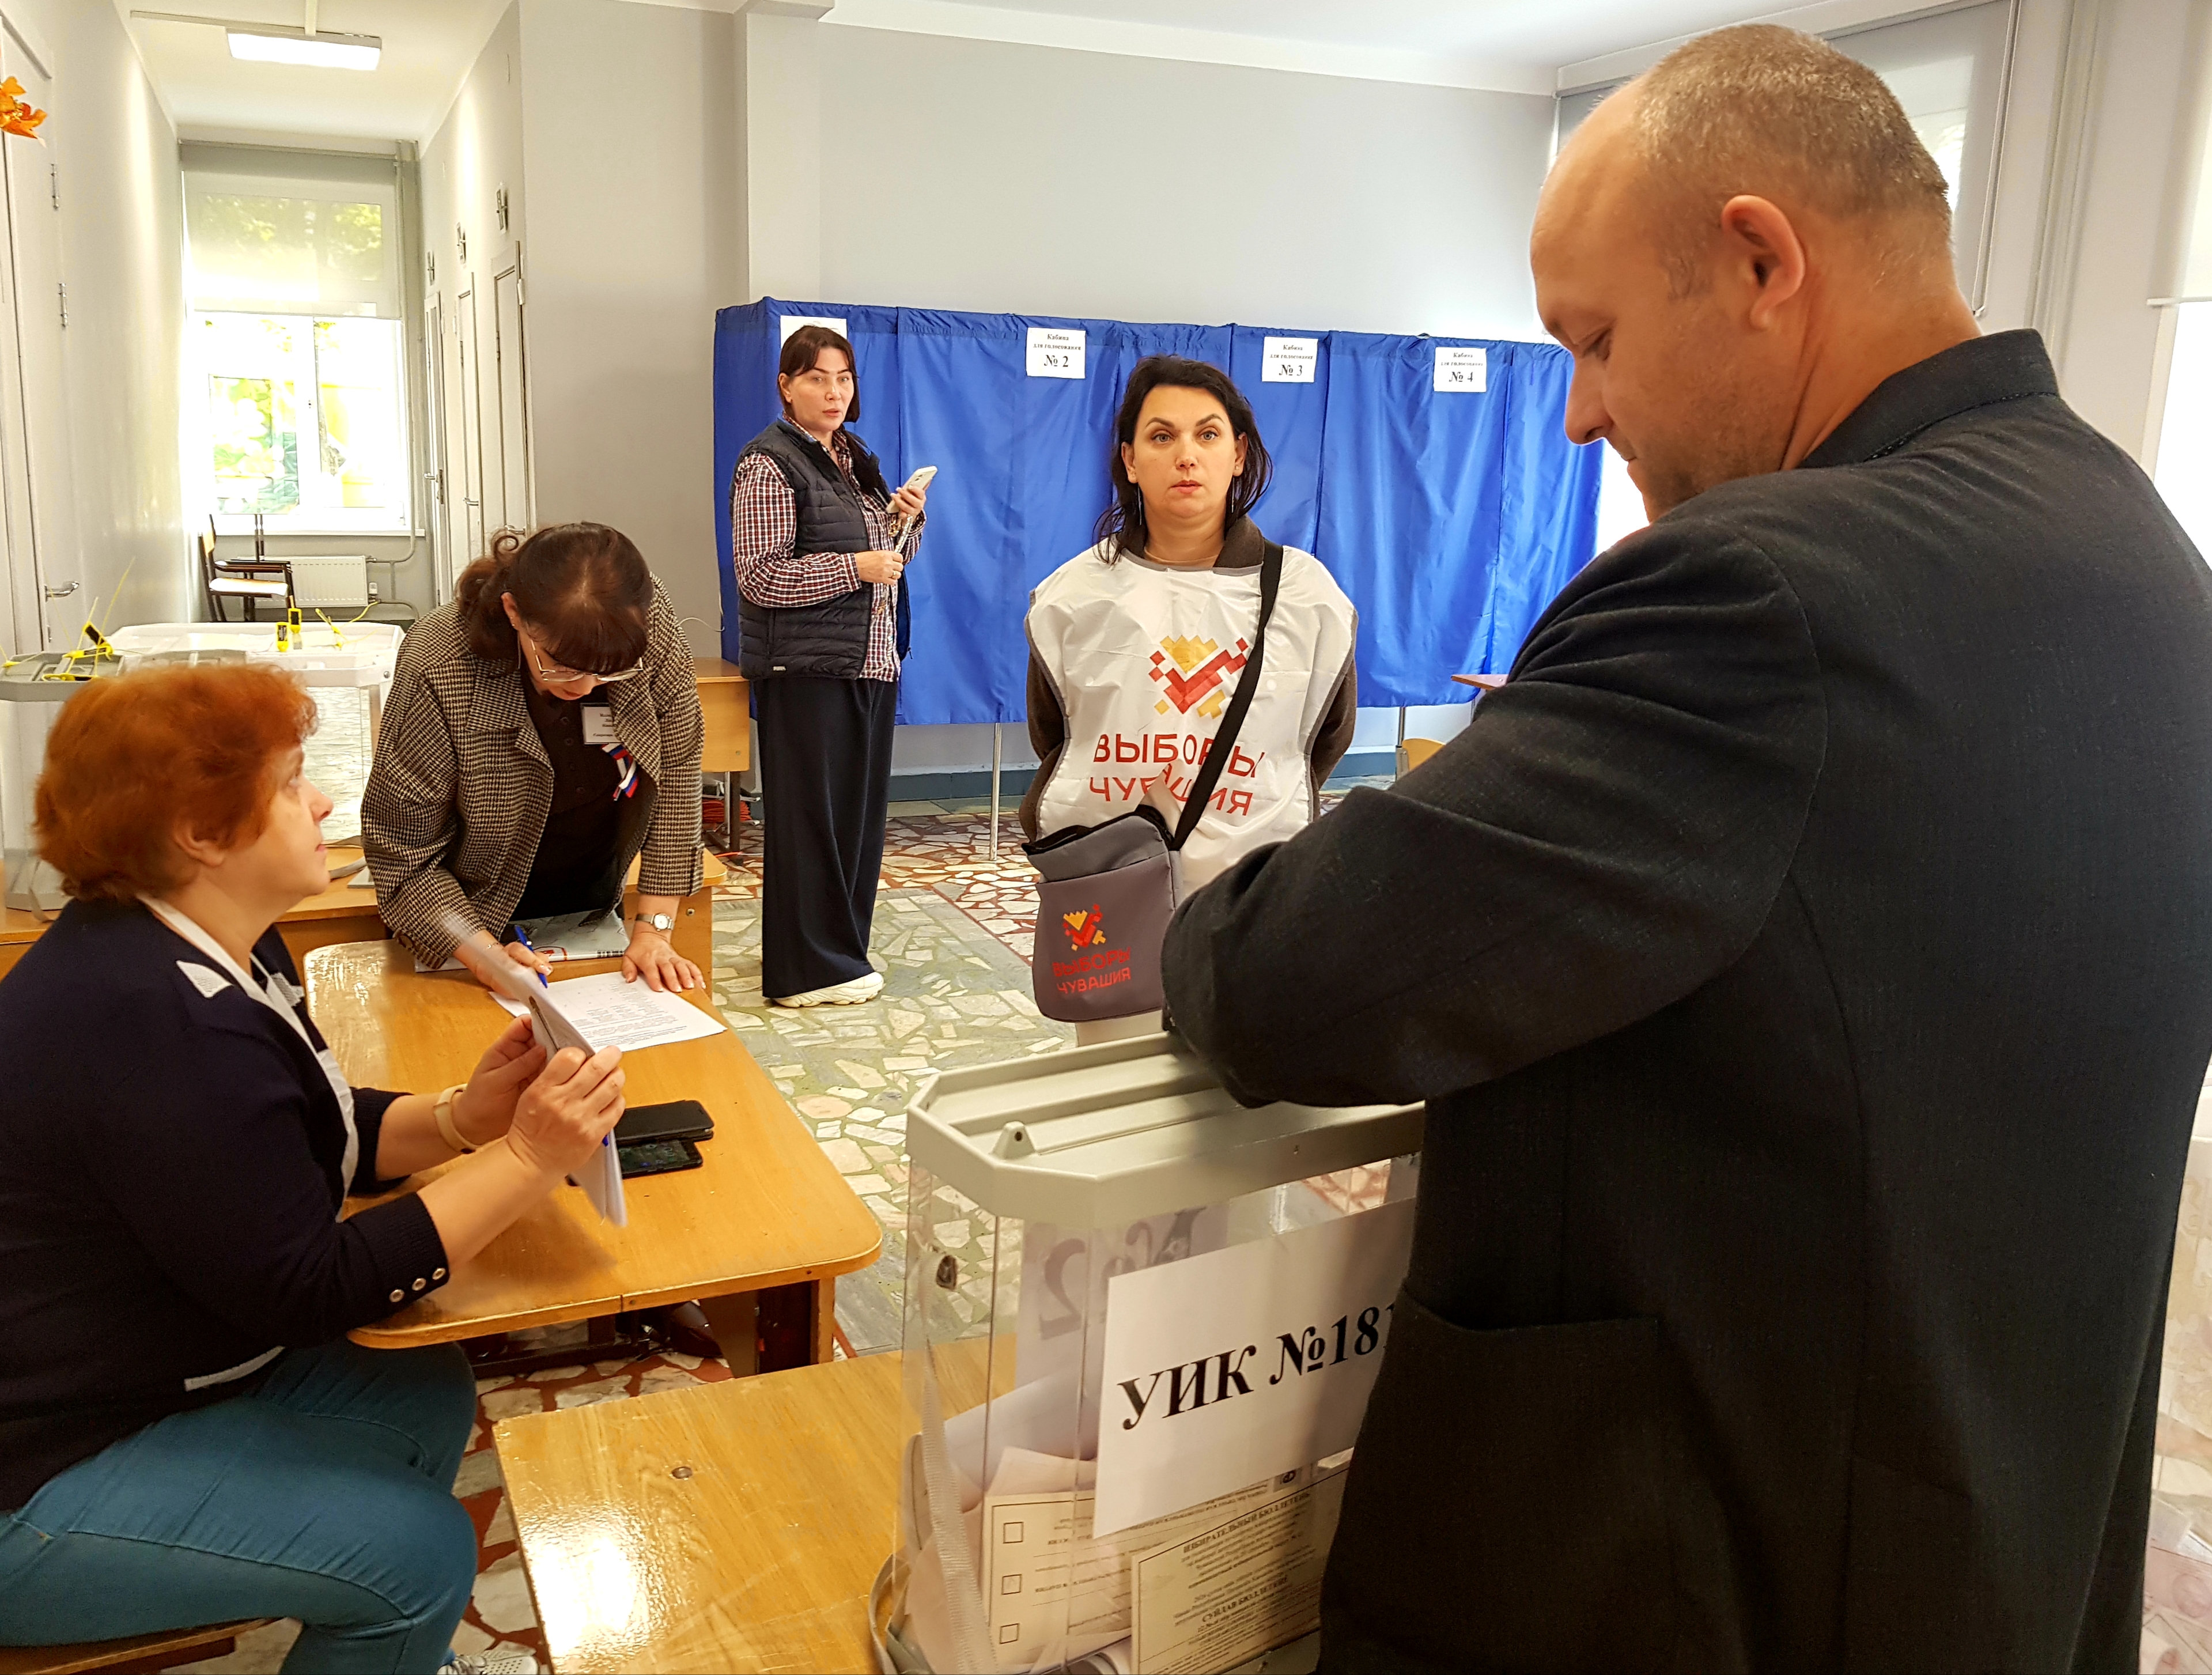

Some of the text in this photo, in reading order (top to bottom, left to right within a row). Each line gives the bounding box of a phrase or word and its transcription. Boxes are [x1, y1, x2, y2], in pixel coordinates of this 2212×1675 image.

[1043, 354, 1069, 367] № 2
[1279, 364, 1303, 376] № 3
[1449, 371, 1473, 382] № 4
[1052, 947, 1131, 977] ВЫБОРЫ
[1056, 967, 1131, 994] ЧУВАШИЯ
[1117, 1303, 1395, 1431] УИК №18
